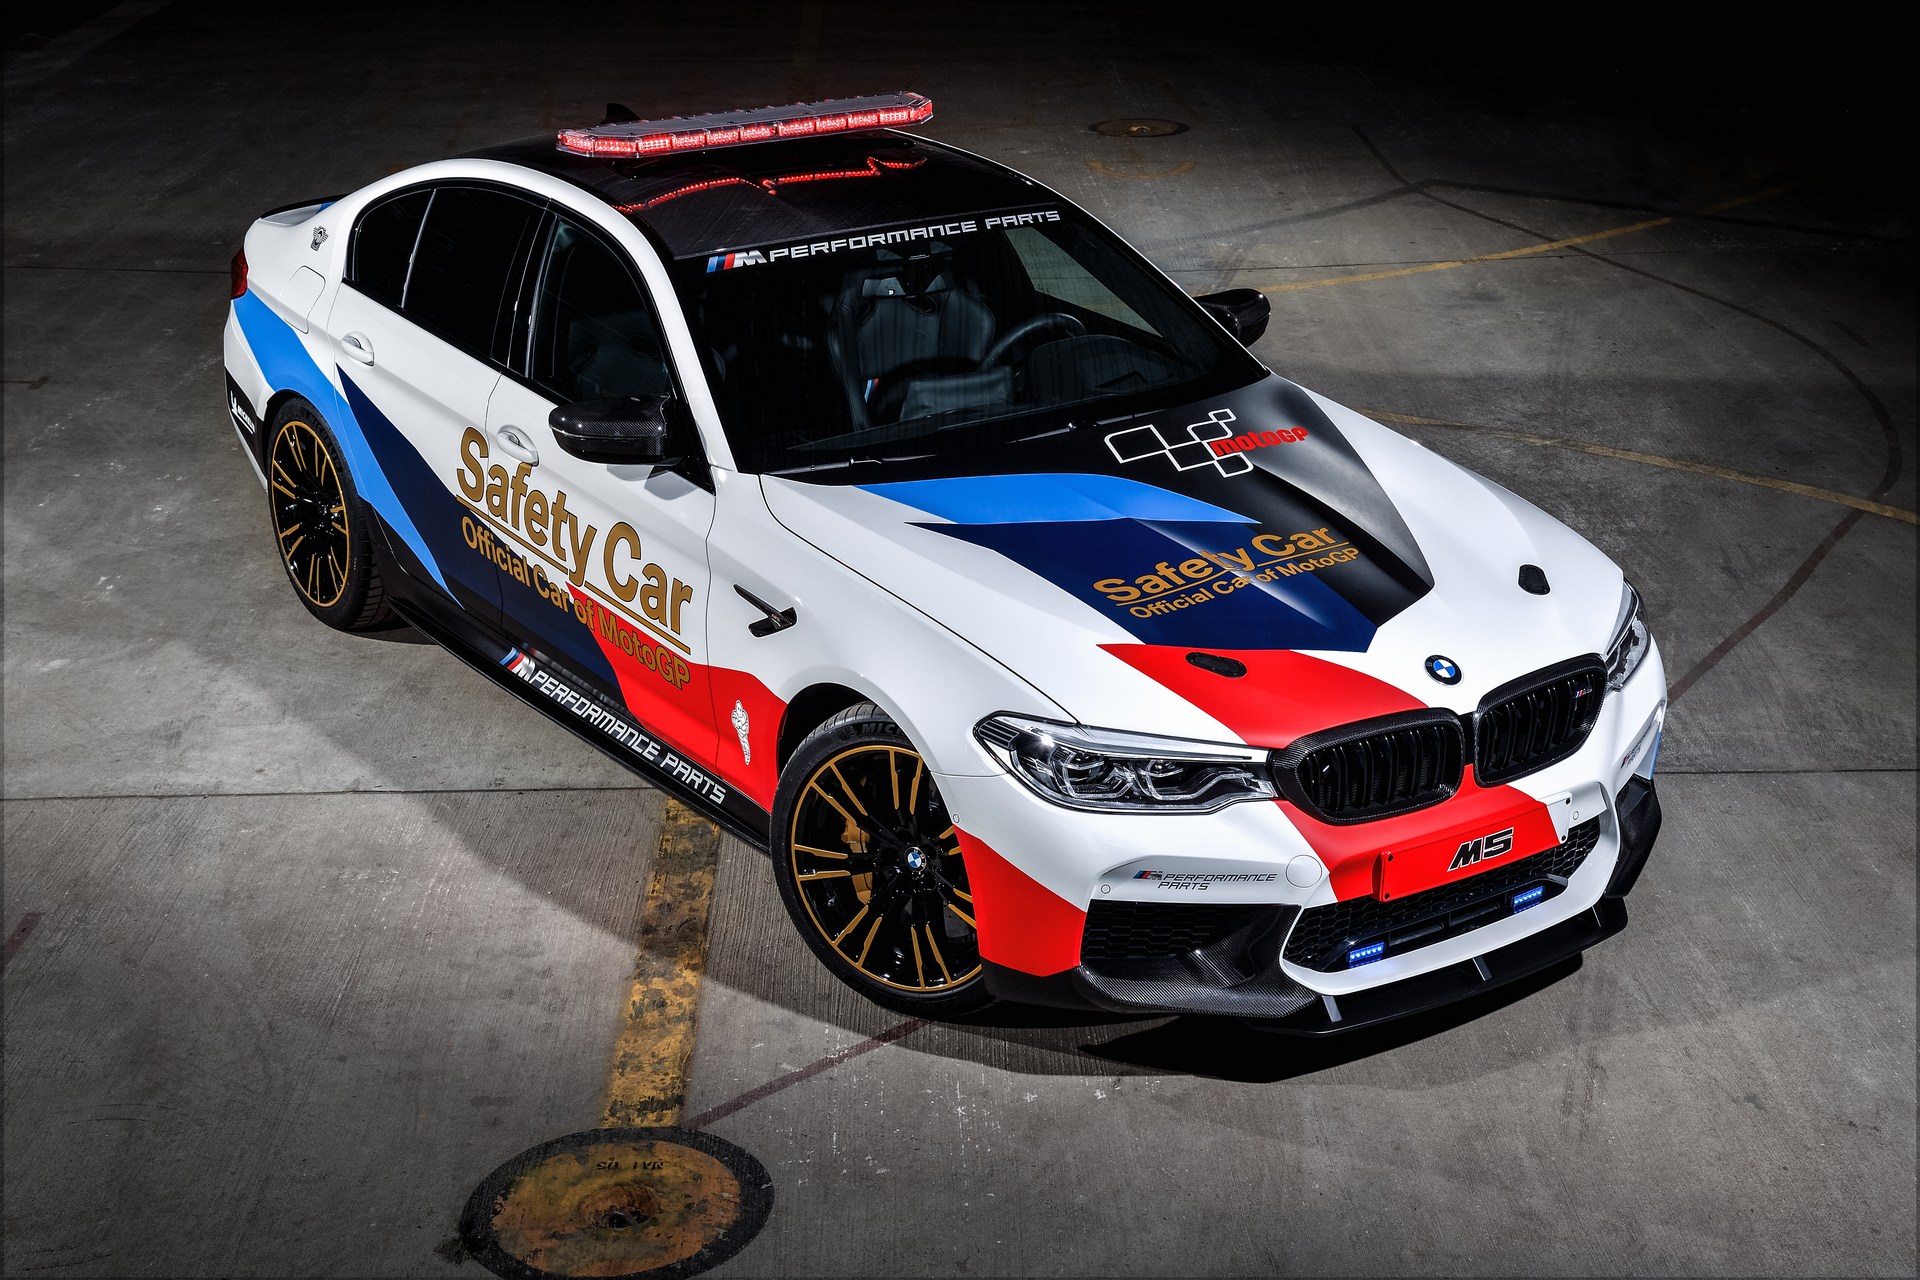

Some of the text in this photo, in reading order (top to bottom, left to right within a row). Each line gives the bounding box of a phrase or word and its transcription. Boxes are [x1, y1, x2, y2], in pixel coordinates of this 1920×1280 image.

[768, 220, 978, 263] PERFORMANCE
[984, 210, 1061, 230] PARTS
[456, 426, 694, 636] Safety Car
[1092, 526, 1337, 601] Safety Car
[461, 515, 691, 692] Official Car of MotoGP
[1128, 547, 1360, 619] Official Car of MotoGP
[528, 669, 662, 761] PERFORMANCE
[659, 751, 727, 805] PARTS
[1163, 873, 1278, 882] PERFORMANCE
[1446, 826, 1515, 873] M5
[1157, 881, 1211, 891] PARTS
